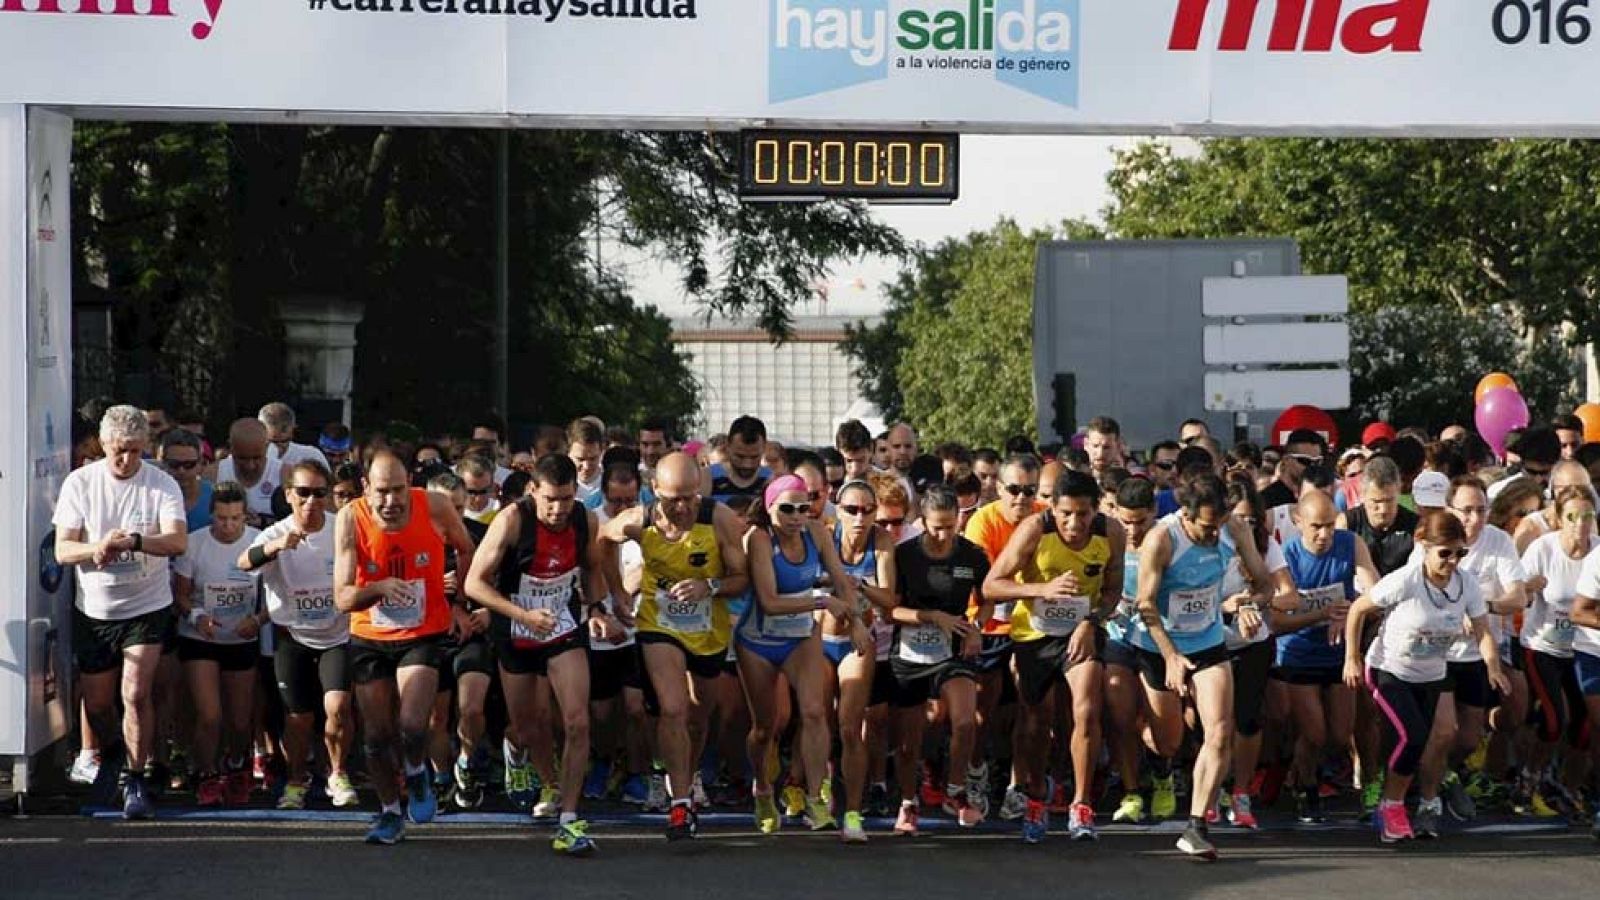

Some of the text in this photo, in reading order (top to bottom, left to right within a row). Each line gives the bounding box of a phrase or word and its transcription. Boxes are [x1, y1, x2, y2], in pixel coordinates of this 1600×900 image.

[1492, 0, 1591, 45] 016
[775, 0, 1070, 66] hay salida
[896, 55, 1070, 74] a la violencia de género
[755, 140, 944, 187] 00:00:00
[294, 594, 334, 610] 1006
[667, 602, 698, 615] 687
[1044, 607, 1077, 619] 686
